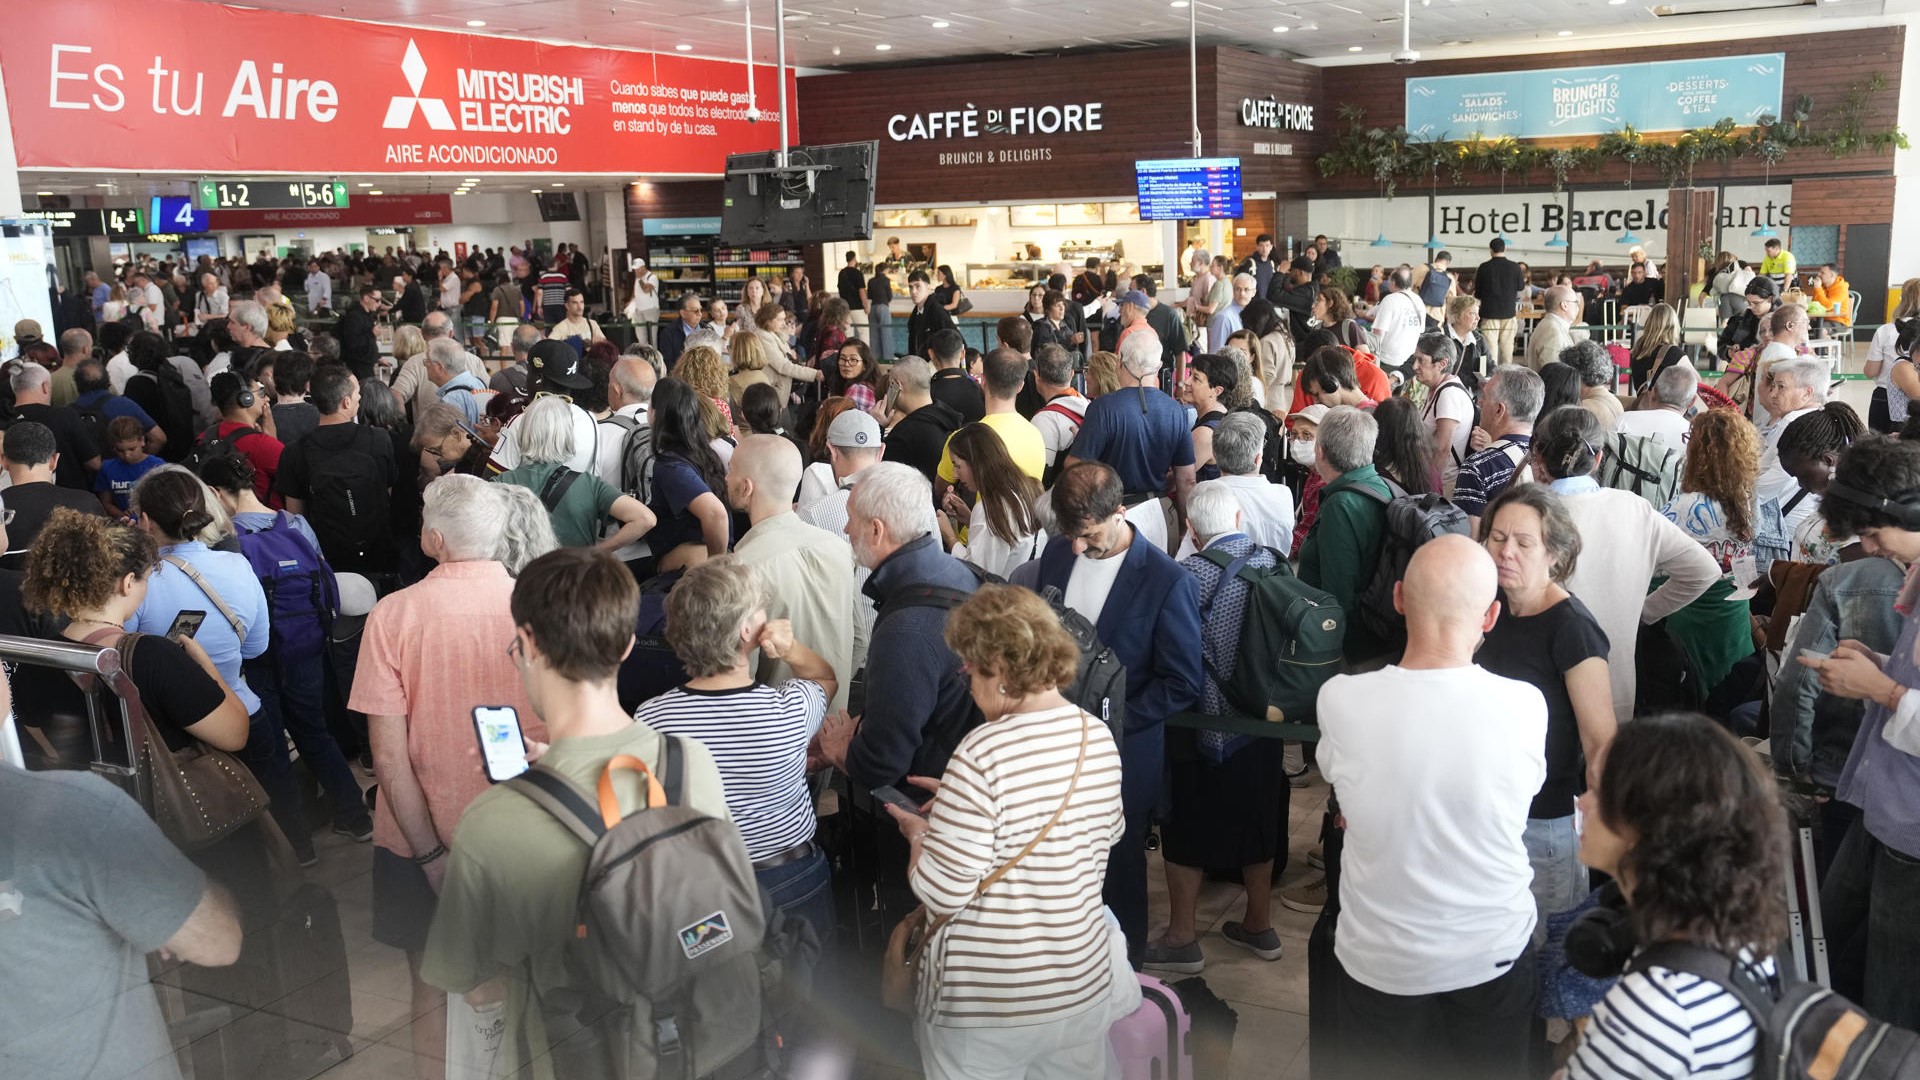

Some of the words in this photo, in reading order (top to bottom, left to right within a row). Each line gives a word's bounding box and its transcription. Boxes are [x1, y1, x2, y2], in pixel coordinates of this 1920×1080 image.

[49, 43, 125, 112] Es
[147, 55, 203, 116] tu
[221, 59, 339, 123] Aire
[456, 67, 584, 106] MITSUBISHI
[610, 79, 648, 96] Cuando
[650, 84, 678, 98] sabes
[680, 88, 698, 103] que
[700, 89, 728, 103] puede
[730, 91, 757, 106] gast
[1553, 82, 1607, 103] BRUNCH
[1610, 82, 1620, 98] &
[1669, 79, 1726, 92] DESSERTS
[612, 101, 646, 114] menos
[648, 102, 666, 118] que
[668, 102, 694, 117] todos
[696, 104, 709, 118] los
[1464, 96, 1503, 108] SALADS
[1556, 98, 1616, 119] DELIGHTS
[1677, 94, 1718, 106] COFFEE
[1693, 104, 1711, 113] TEA
[460, 101, 571, 135] ELECTRIC
[888, 102, 979, 141] CAFFÈ
[987, 109, 1002, 123] DI
[1010, 102, 1103, 135] FIORE
[1242, 94, 1275, 128] CAFFÈ
[1285, 103, 1314, 131] FIORE
[1452, 110, 1518, 123] SANDWICHES
[613, 119, 626, 132] en
[628, 118, 654, 132] stand
[656, 118, 668, 136] by
[670, 120, 682, 134] de
[684, 120, 693, 135] tu
[694, 123, 718, 136] casa.
[385, 144, 423, 163] AIRE
[428, 145, 557, 165] ACONDICIONADO
[939, 151, 983, 165] BRUNCH
[988, 150, 995, 163] &
[1000, 148, 1052, 162] DELIGHTS
[110, 210, 125, 233] 4
[174, 202, 194, 227] 4
[1440, 202, 1532, 234] Hotel
[1715, 200, 1792, 229] ants
